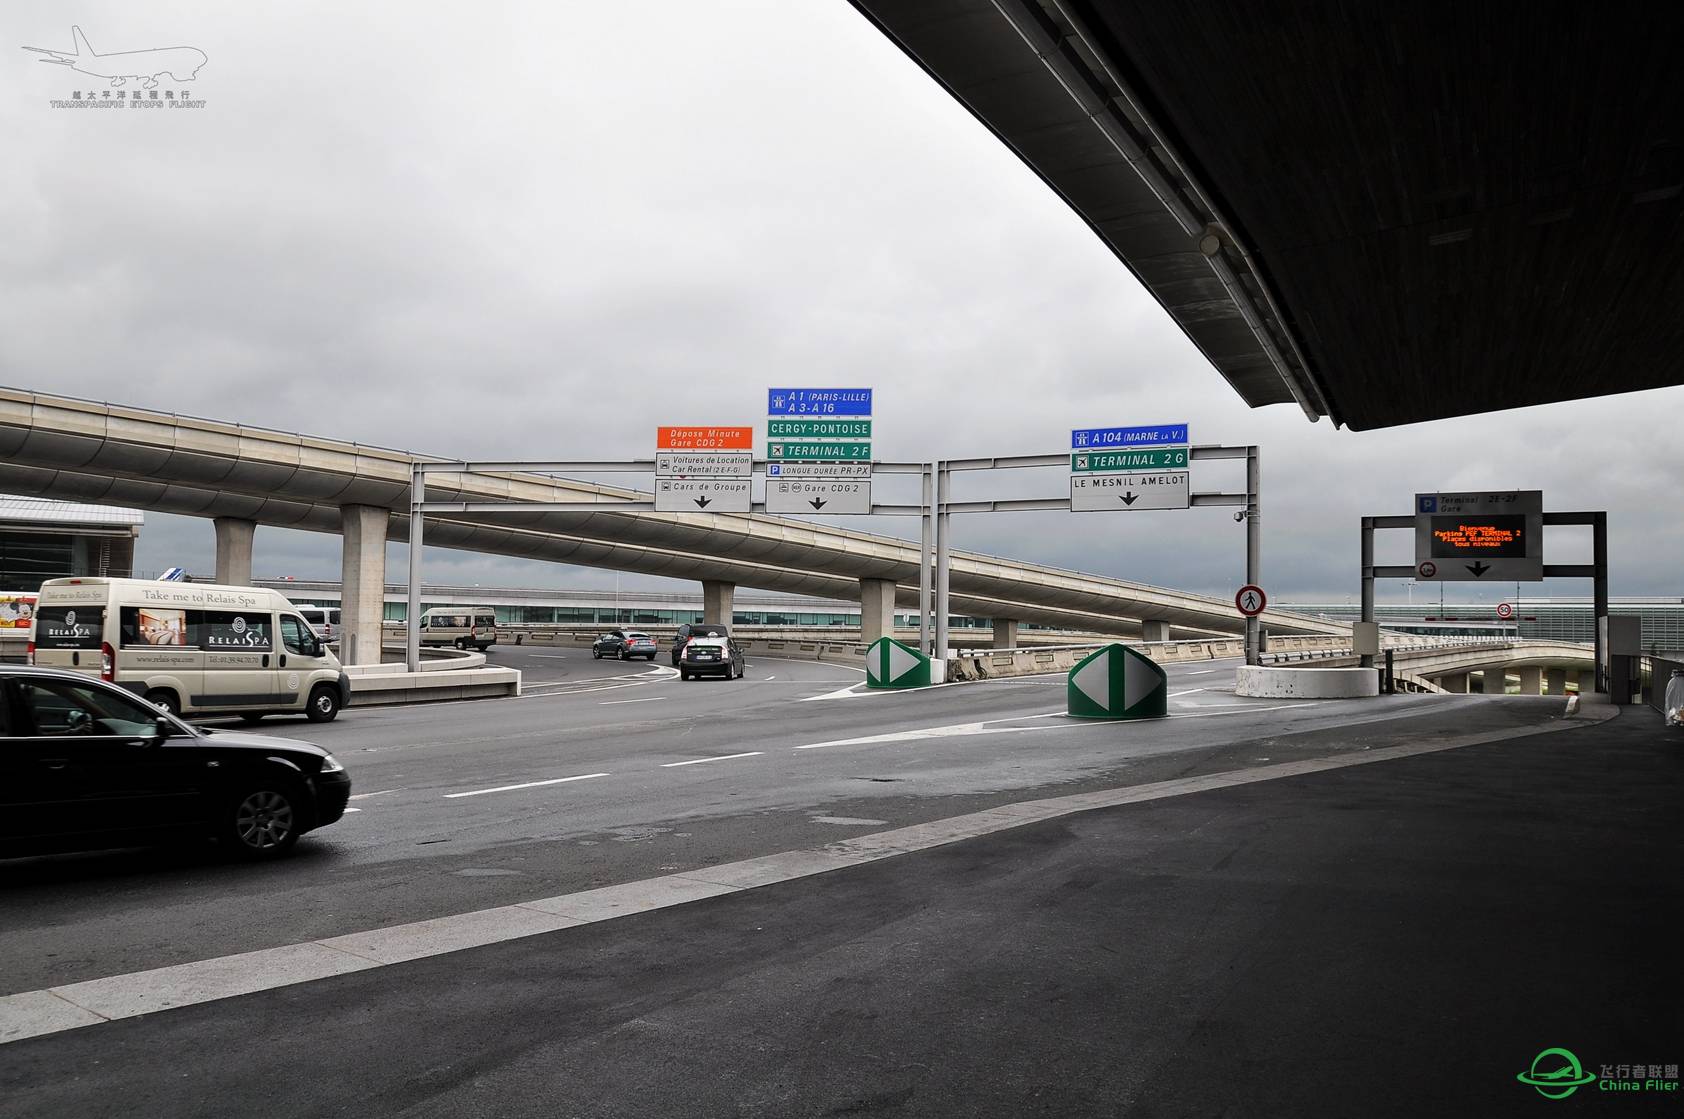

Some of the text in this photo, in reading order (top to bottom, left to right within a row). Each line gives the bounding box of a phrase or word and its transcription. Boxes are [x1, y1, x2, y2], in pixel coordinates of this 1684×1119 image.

[808, 392, 869, 402] (PARIS-LILLE)
[771, 424, 868, 434] CERGY-PONTOISE
[670, 430, 703, 438] Dépose
[1124, 432, 1158, 442] (MARNE
[788, 446, 846, 456] TERMINAL
[673, 456, 704, 464] Voitures
[1094, 454, 1155, 467] TERMINAL
[783, 466, 811, 474] LONGUE
[814, 466, 837, 474] DURÉE
[1074, 476, 1184, 488] LE MESNIL AMELOT
[714, 483, 746, 492] Groupe
[804, 484, 826, 492] Gare
[831, 484, 850, 492] CDG
[853, 484, 859, 492] 2
[1440, 496, 1479, 504] Terminal
[1441, 505, 1461, 513] Gare
[143, 590, 169, 600] Take
[192, 593, 202, 601] to
[207, 594, 236, 604] Relais
[238, 596, 256, 607] Spa
